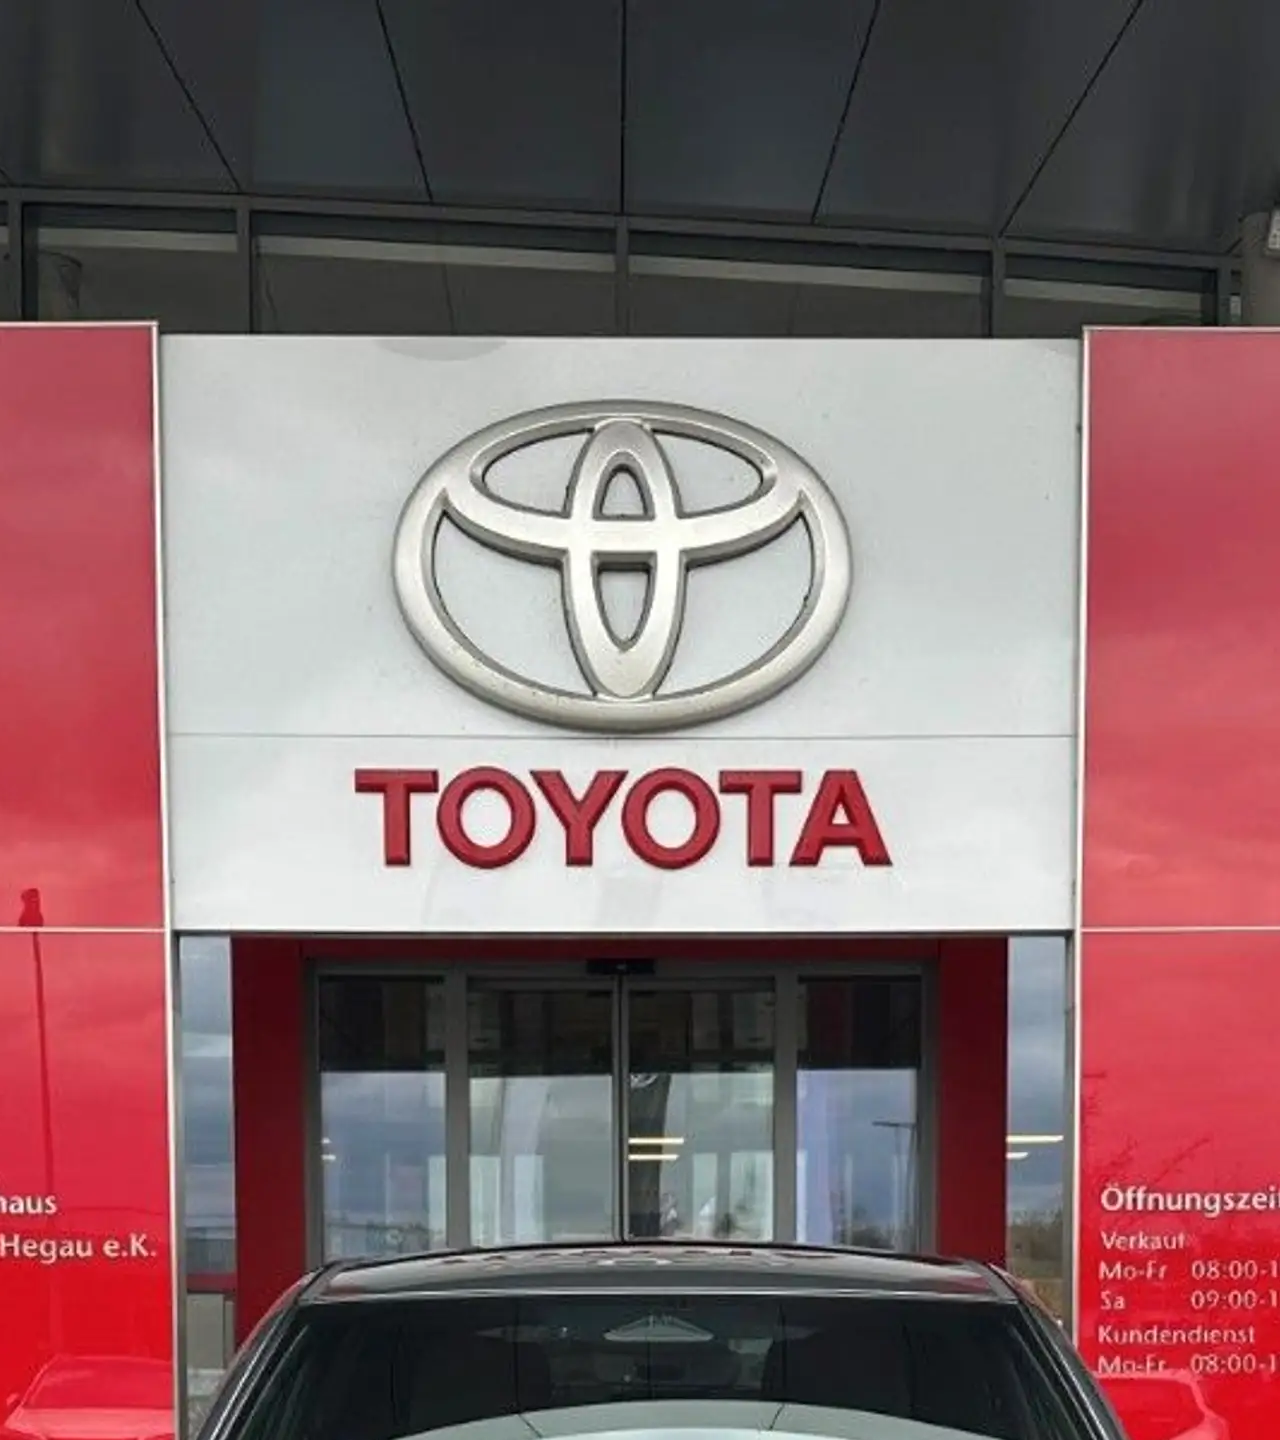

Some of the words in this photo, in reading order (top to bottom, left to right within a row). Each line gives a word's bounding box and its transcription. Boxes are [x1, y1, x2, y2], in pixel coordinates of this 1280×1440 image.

[354, 766, 893, 869] TOYOTA
[102, 1232, 158, 1259] e.K.
[1100, 1230, 1187, 1250] Verkauf
[1098, 1259, 1169, 1281] Mo-Fr
[1099, 1289, 1127, 1311] Sa
[1097, 1324, 1256, 1345] Kundendienst
[1097, 1355, 1166, 1374] Mo-Fr
